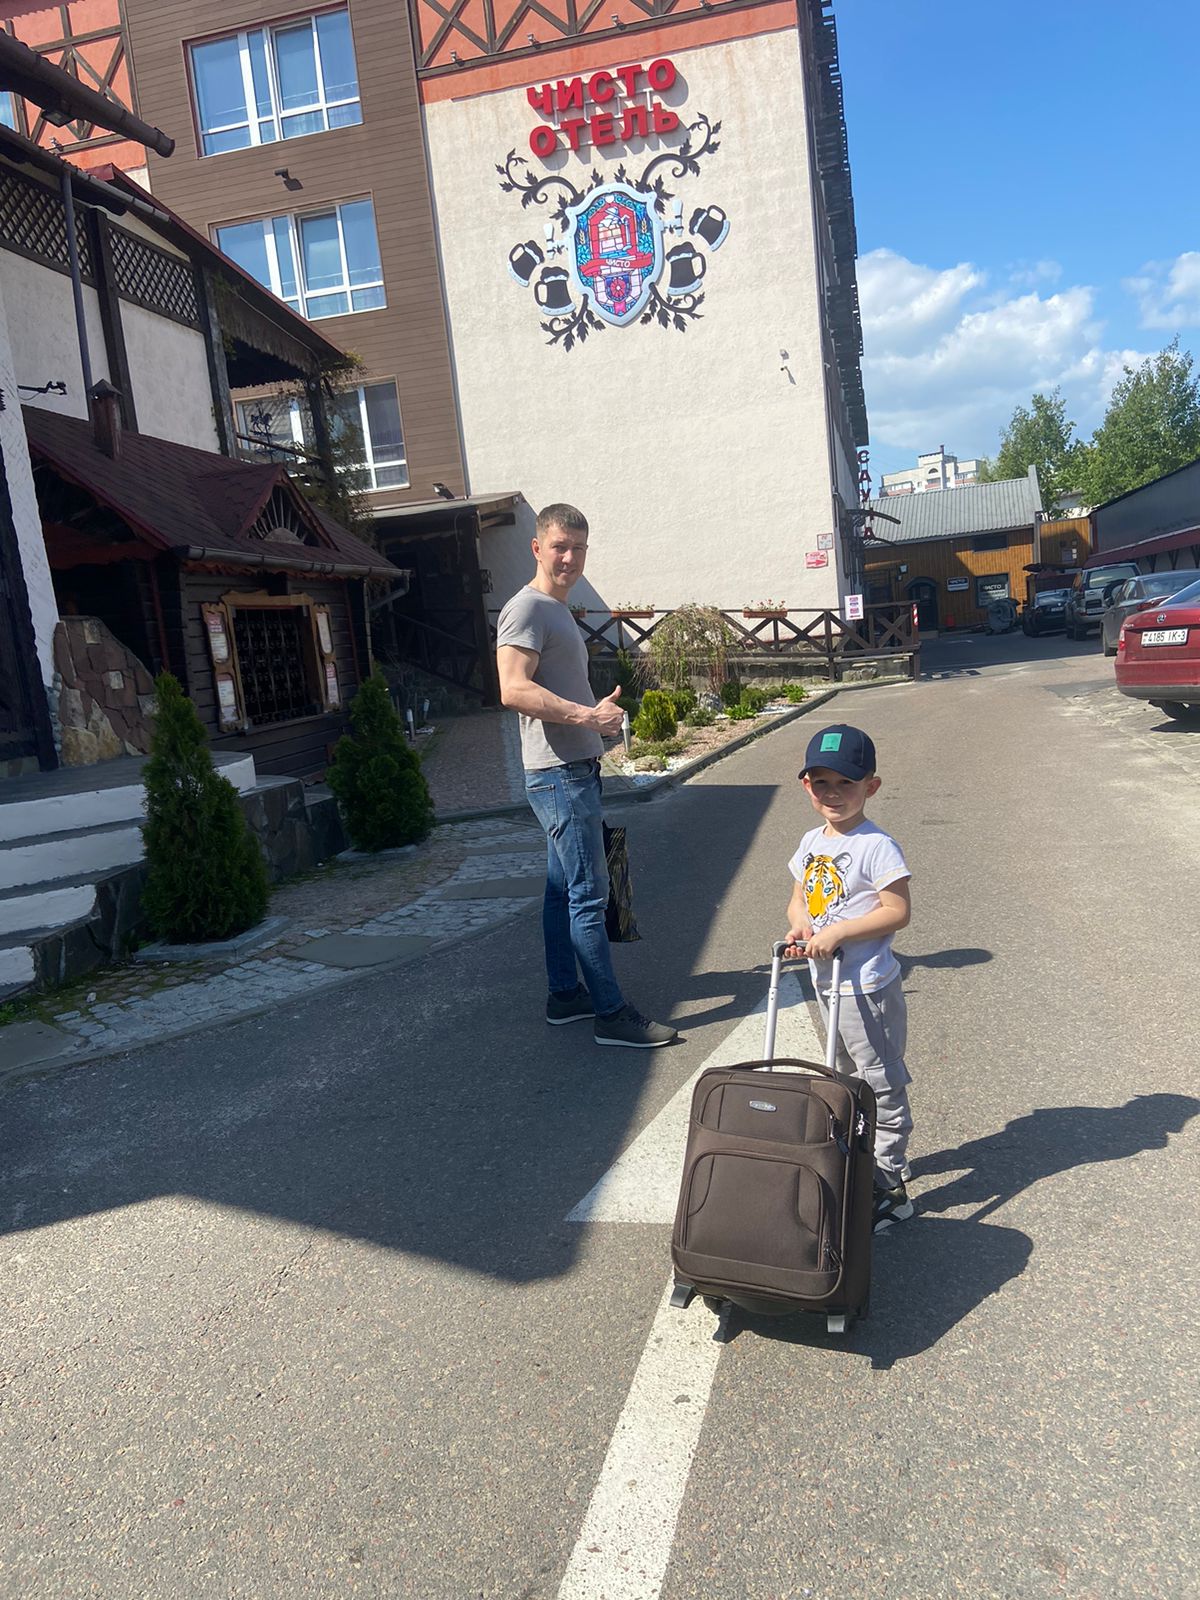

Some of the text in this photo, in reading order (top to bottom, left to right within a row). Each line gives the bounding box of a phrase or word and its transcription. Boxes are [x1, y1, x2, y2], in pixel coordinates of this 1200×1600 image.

[526, 58, 677, 115] ЧИСТО
[529, 102, 680, 158] ОТЕЛЬ
[605, 258, 631, 268] ЧИСТО
[1148, 631, 1165, 642] 4185
